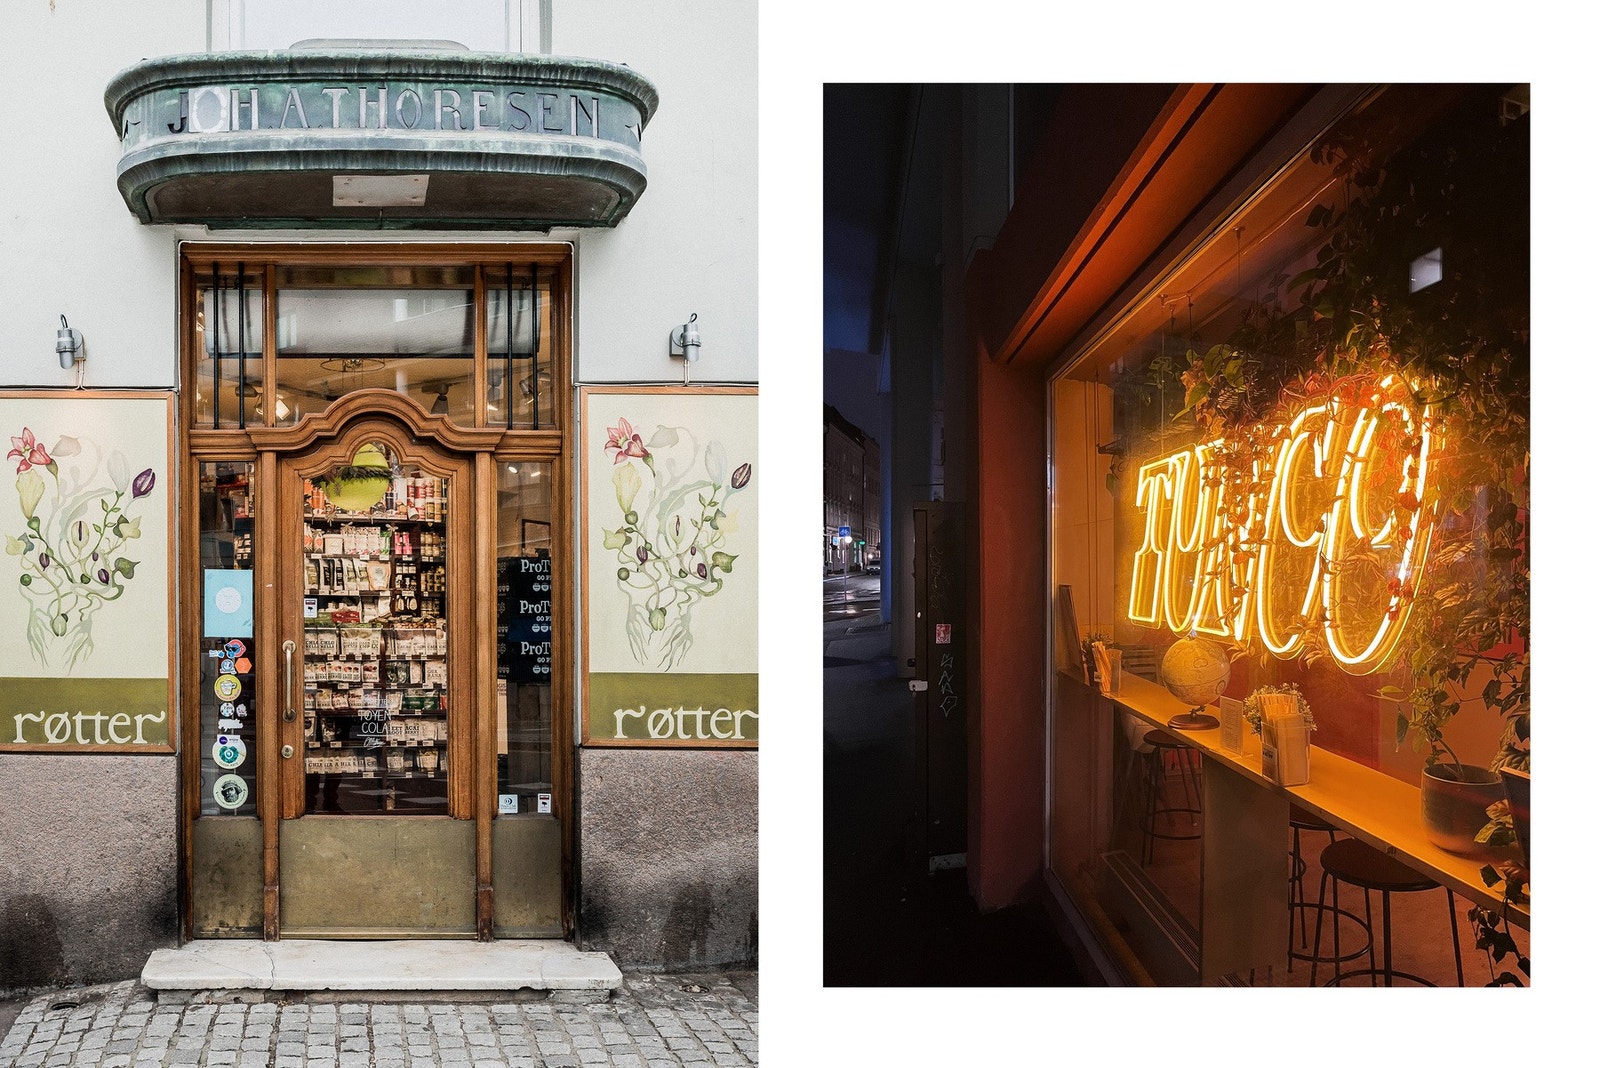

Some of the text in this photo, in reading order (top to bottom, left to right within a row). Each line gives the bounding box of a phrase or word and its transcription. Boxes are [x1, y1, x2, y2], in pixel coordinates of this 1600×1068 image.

[521, 559, 551, 573] ProT
[519, 600, 551, 614] ProT
[521, 642, 551, 655] ProT
[13, 711, 165, 744] røtter
[613, 706, 759, 739] røtter
